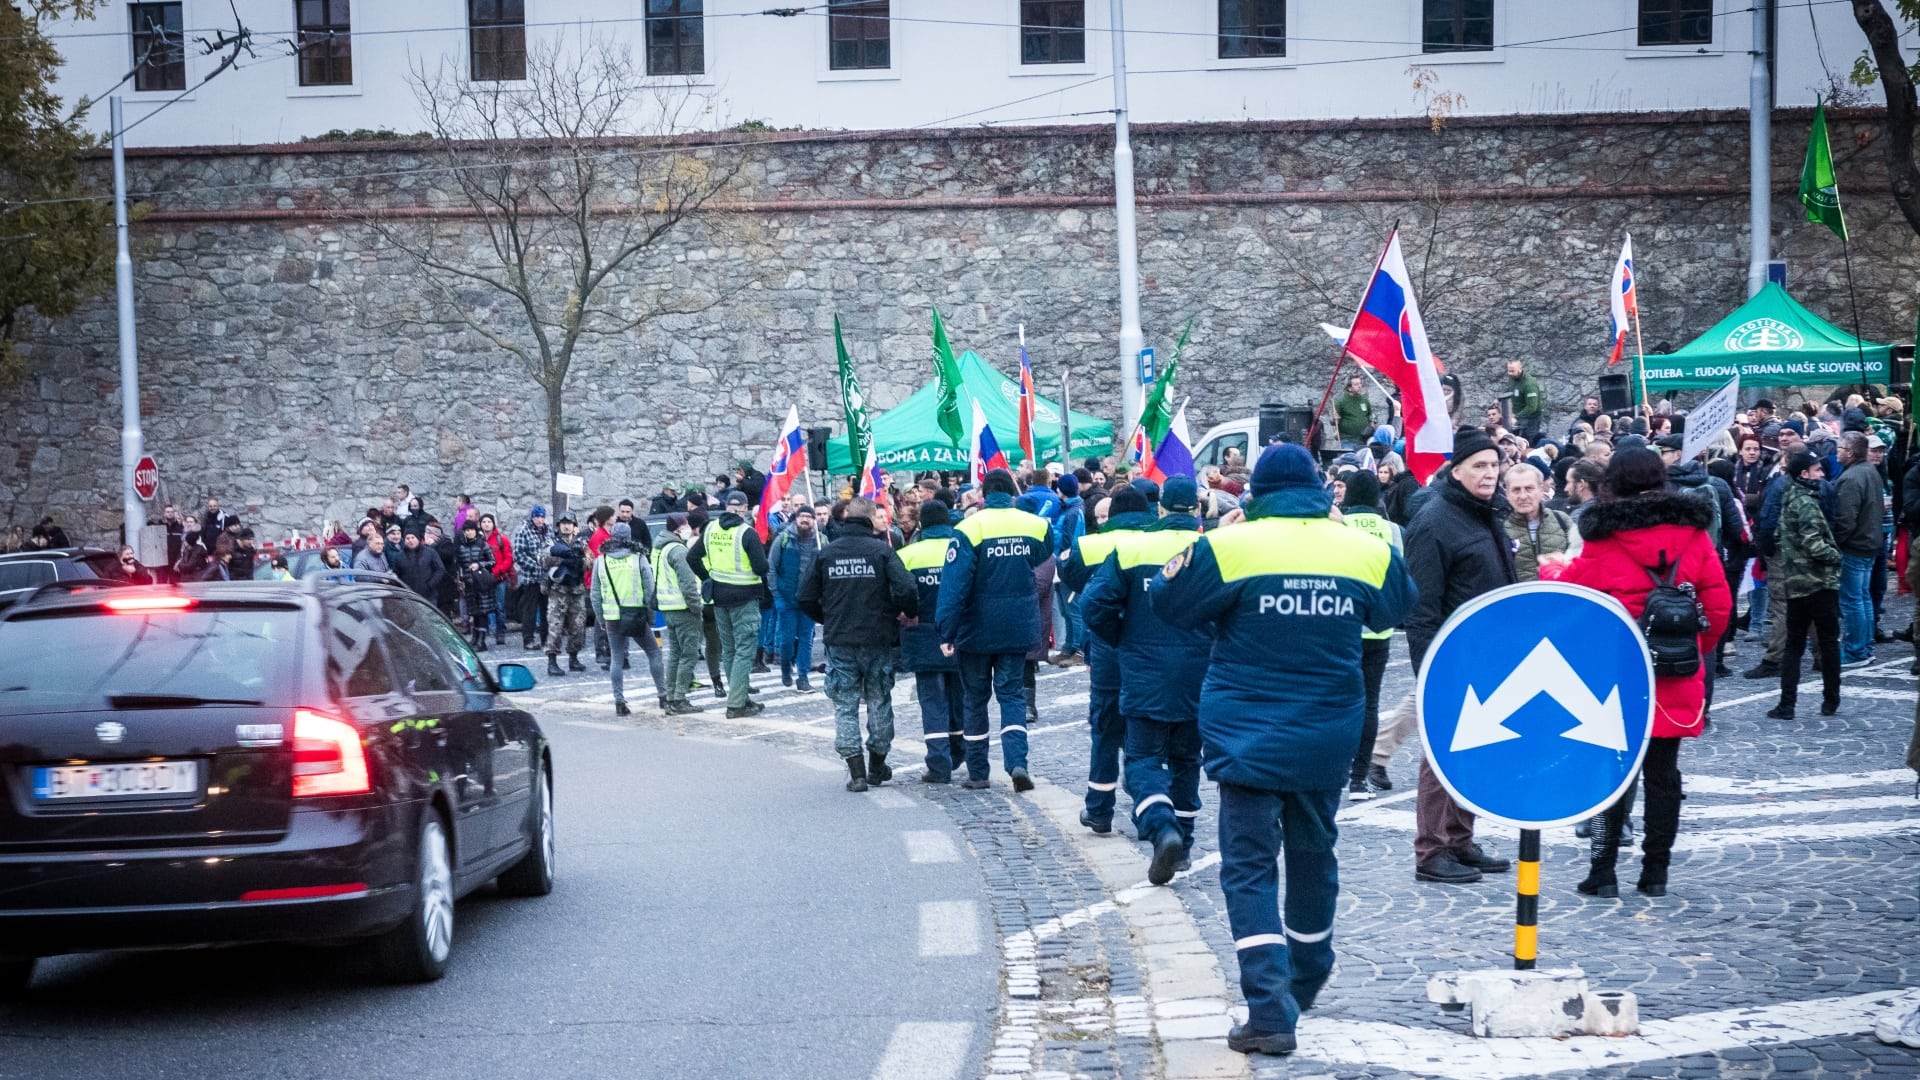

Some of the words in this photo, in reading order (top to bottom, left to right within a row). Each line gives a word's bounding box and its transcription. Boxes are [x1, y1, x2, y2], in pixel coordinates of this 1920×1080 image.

[1738, 319, 1793, 336] KOTLEBA
[1742, 363, 1784, 375] STRANA
[1787, 361, 1816, 373] NAŠE
[920, 448, 931, 462] A
[934, 448, 953, 462] ZA
[136, 469, 157, 486] STOP
[1354, 518, 1377, 528] 108
[987, 543, 1031, 558] POLÍCIA
[828, 564, 876, 576] POLÍCIA
[1283, 578, 1338, 590] MESTSKÁ
[1259, 590, 1354, 616] POLÍCIA
